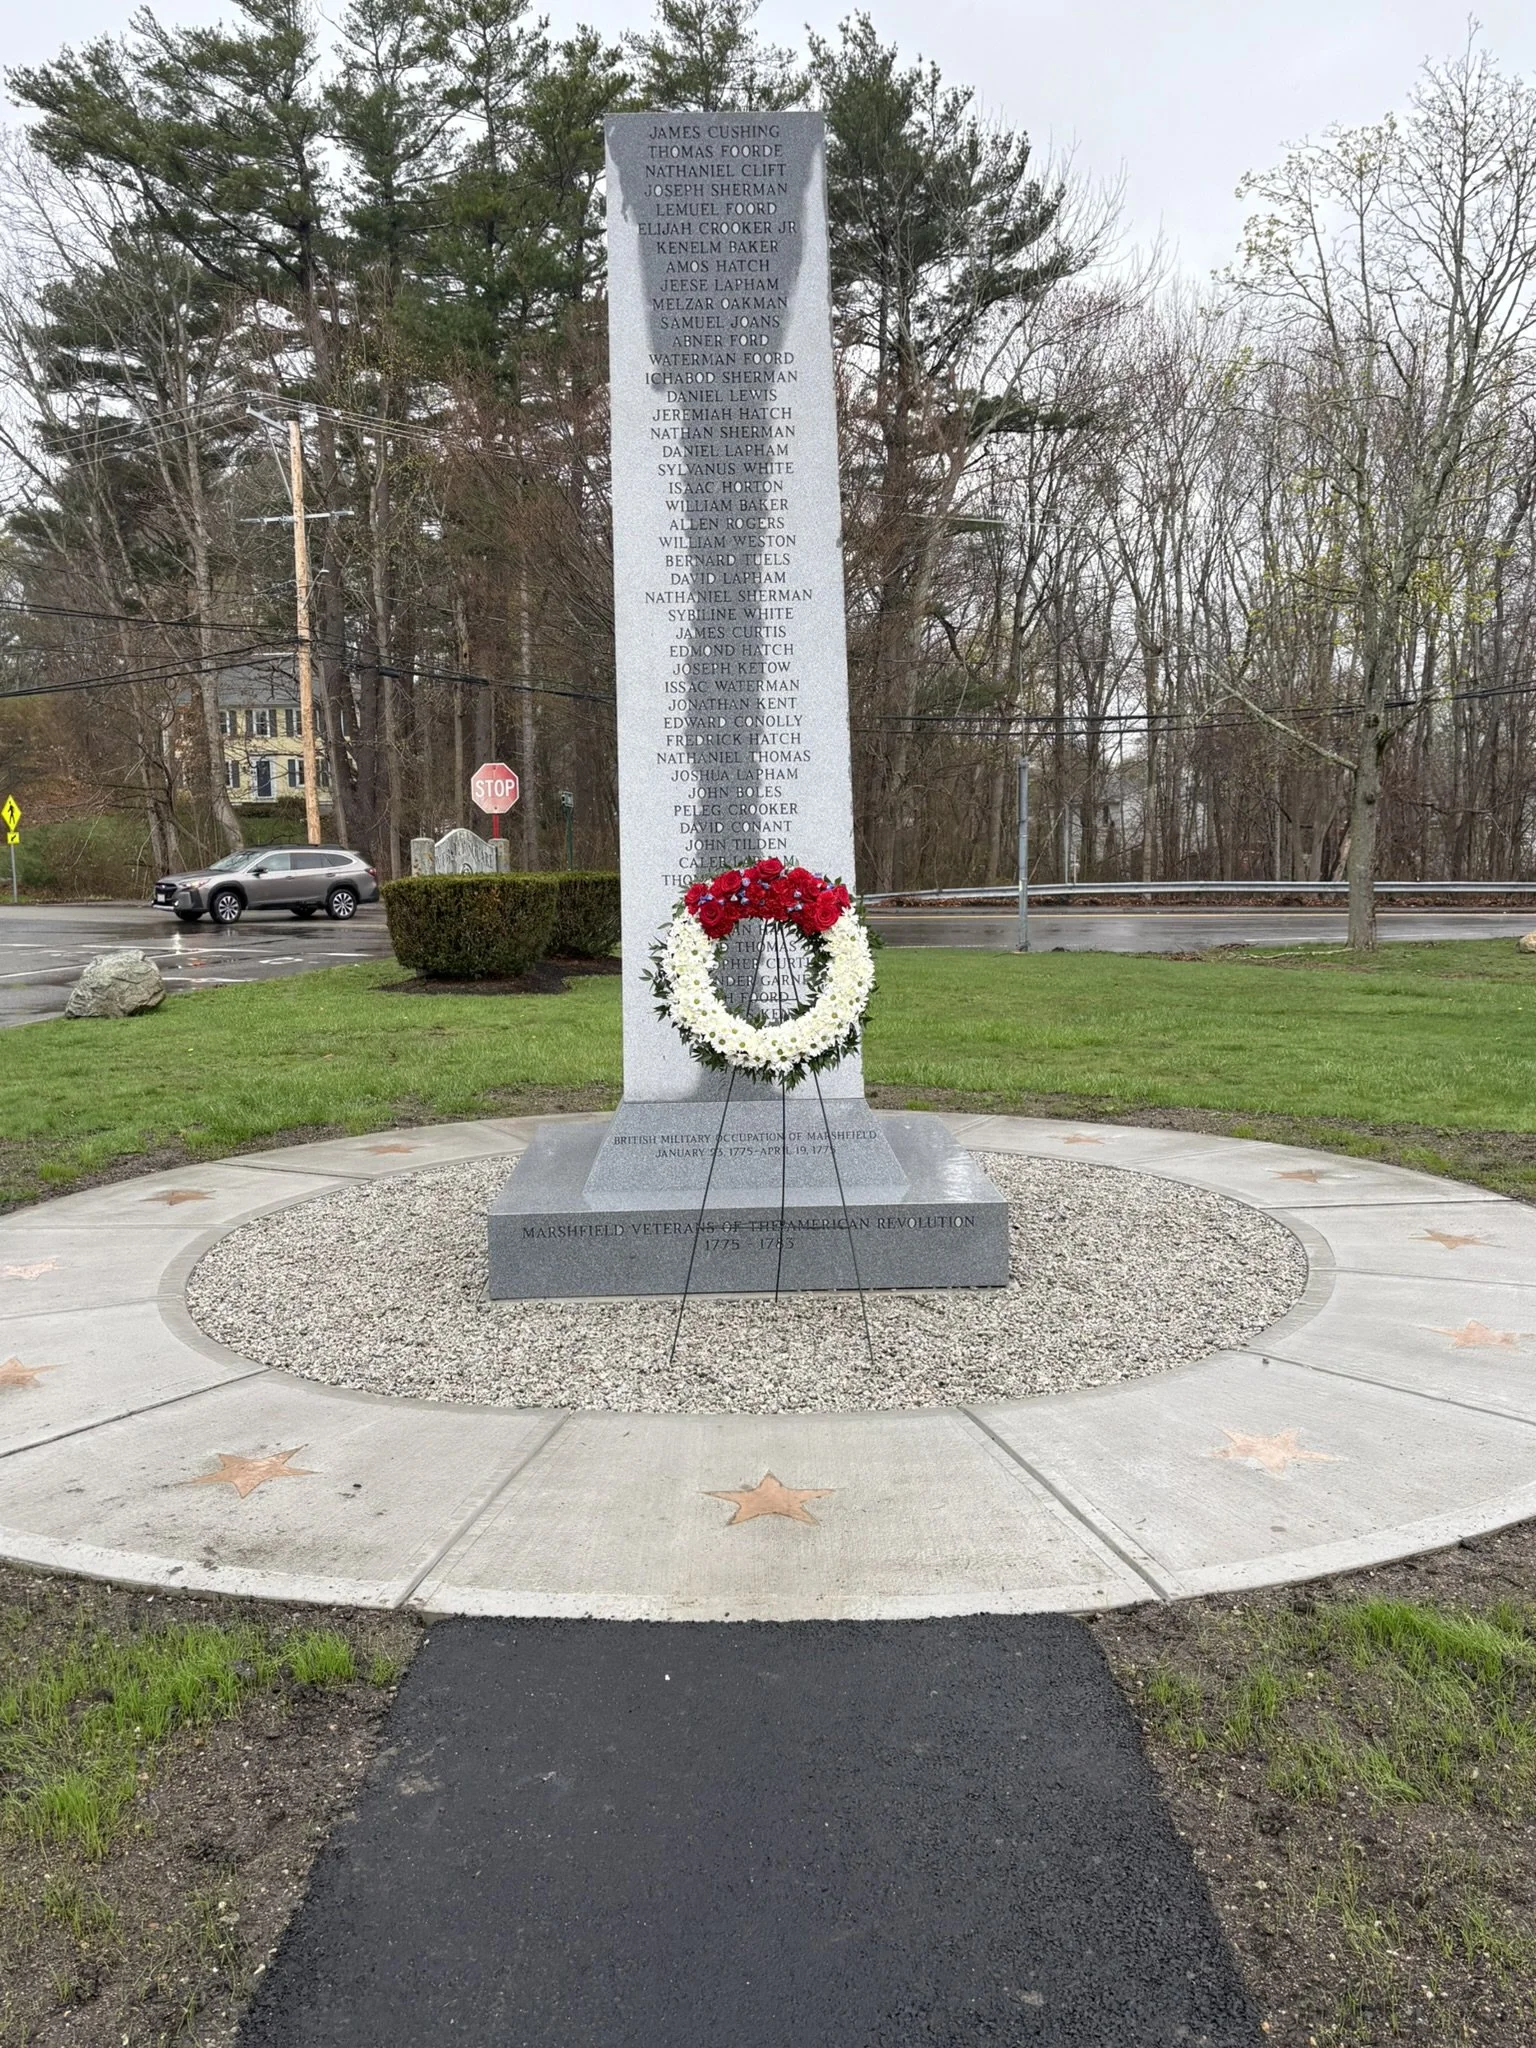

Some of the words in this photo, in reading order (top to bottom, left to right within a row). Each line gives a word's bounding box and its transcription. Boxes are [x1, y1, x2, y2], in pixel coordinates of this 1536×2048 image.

[650, 126, 700, 140] JAMES
[708, 125, 779, 139] CUSHING
[649, 146, 713, 159] THOMAS
[721, 145, 783, 158] FOORDE
[646, 165, 734, 178] NATHANIEL
[742, 164, 787, 177] CLIFT
[644, 184, 704, 197] JOSEPH
[712, 183, 788, 196] SHERMAN
[657, 203, 719, 216] LEMUEL
[727, 203, 777, 215] FOORD
[639, 223, 692, 236] ELIJAH
[699, 222, 772, 235] CROOKER
[778, 221, 797, 234] JR
[657, 242, 721, 254] KENELM
[730, 240, 778, 253] BAKER
[666, 261, 709, 273] AMOS
[716, 259, 770, 272] HATCH
[660, 280, 708, 292] JEESE
[715, 278, 779, 291] LAPHAM
[653, 298, 714, 311] MELZAR
[721, 297, 788, 310] OAKMAN
[661, 316, 724, 329] SAMUEL
[731, 315, 780, 328] JOANS
[672, 335, 722, 348] ABNER
[730, 334, 769, 347] FORD
[649, 354, 735, 366] WATERMAN
[744, 352, 794, 365] FOORD
[646, 372, 716, 385] ICHABOD
[723, 371, 797, 384] SHERMAN
[667, 390, 723, 403] DANIEL
[730, 389, 777, 402] LEWIS
[653, 408, 731, 422] JEREMIAH
[739, 407, 792, 420] HATCH
[650, 427, 713, 440] NATHAN
[720, 426, 795, 439] SHERMAN
[663, 445, 719, 458] DANIEL
[726, 444, 788, 457] LAPHAM
[658, 463, 735, 476] SYLVANUS
[744, 462, 794, 475] WHITE
[669, 482, 715, 494] ISAAC
[723, 480, 783, 493] HORTON
[665, 499, 732, 512] WILLIAM
[740, 498, 788, 511] BAKER
[670, 518, 719, 530] ALLEN
[727, 517, 784, 530] ROGERS
[659, 536, 726, 548] WILLIAM
[732, 535, 796, 548] WESTON
[665, 554, 735, 567] BERNARD
[743, 553, 790, 566] TUELS
[671, 573, 716, 585] DAVID
[723, 572, 786, 584] LAPHAM
[645, 591, 731, 603] NATHANIEL
[738, 590, 812, 602] SHERMAN
[668, 609, 736, 621] SYBILINE
[744, 608, 793, 620] WHITE
[676, 627, 725, 639] JAMES
[732, 626, 786, 638] CURTIS
[670, 645, 735, 657] EDMOND
[742, 644, 794, 656] HATCH
[673, 663, 730, 675] JOSEPH
[738, 662, 791, 674] KETOW
[665, 681, 709, 693] ISSAC
[715, 680, 800, 692] WATERMAN
[668, 699, 749, 711] JONATHAN
[757, 698, 797, 710] KENT
[664, 717, 727, 728] EDWARD
[734, 715, 803, 727] CONOLLY
[666, 734, 741, 746] FREDRICK
[749, 733, 801, 745] HATCH
[657, 752, 741, 764] NATHANIEL
[748, 751, 811, 763] THOMAS
[671, 769, 729, 782] JOSHUA
[737, 768, 798, 780] LAPHAM
[475, 780, 516, 798] STOP
[688, 787, 729, 799] JOHN
[736, 786, 782, 798] BOLES
[674, 804, 721, 816] PELEG
[729, 803, 798, 815] CROOKER
[680, 822, 724, 834] DAVID
[732, 821, 793, 833] CONANT
[685, 839, 726, 851] JOHN
[733, 838, 787, 850] TILDEN
[736, 941, 797, 952] THOMAS
[766, 957, 810, 969] CURTI
[614, 1135, 656, 1145] BRITISH
[661, 1134, 710, 1144] MILITARY
[716, 1132, 784, 1143] OCCUPATION
[788, 1132, 803, 1140] OF
[807, 1130, 878, 1140] MARSHFIELD
[655, 1148, 705, 1158] JANUARY
[522, 1225, 625, 1239] MARSHFIELD
[632, 1222, 716, 1235] VETERANS
[722, 1222, 741, 1233] OF
[785, 1219, 869, 1231] AMERICAN
[877, 1216, 976, 1229] REVOLUTION
[705, 1240, 740, 1251] 1775
[760, 1239, 794, 1250] 1783
